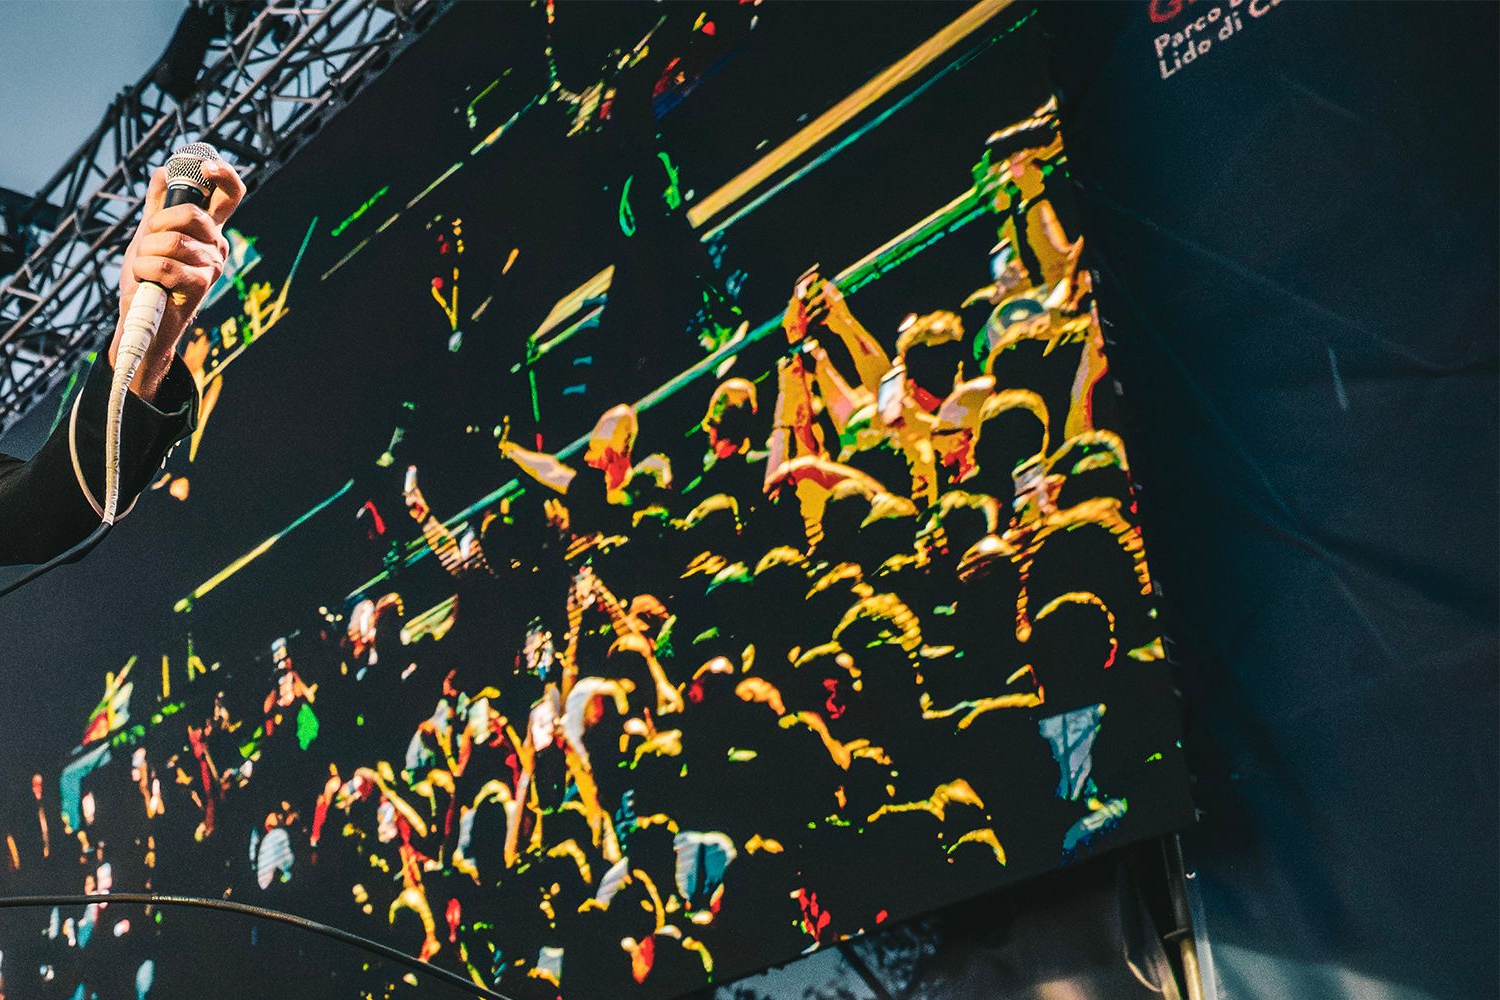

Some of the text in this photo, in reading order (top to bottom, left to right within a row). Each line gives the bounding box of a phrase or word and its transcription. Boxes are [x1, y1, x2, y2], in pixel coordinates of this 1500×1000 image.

[1153, 7, 1222, 58] Parco
[1159, 40, 1212, 79] Lido
[1218, 11, 1243, 41] di
